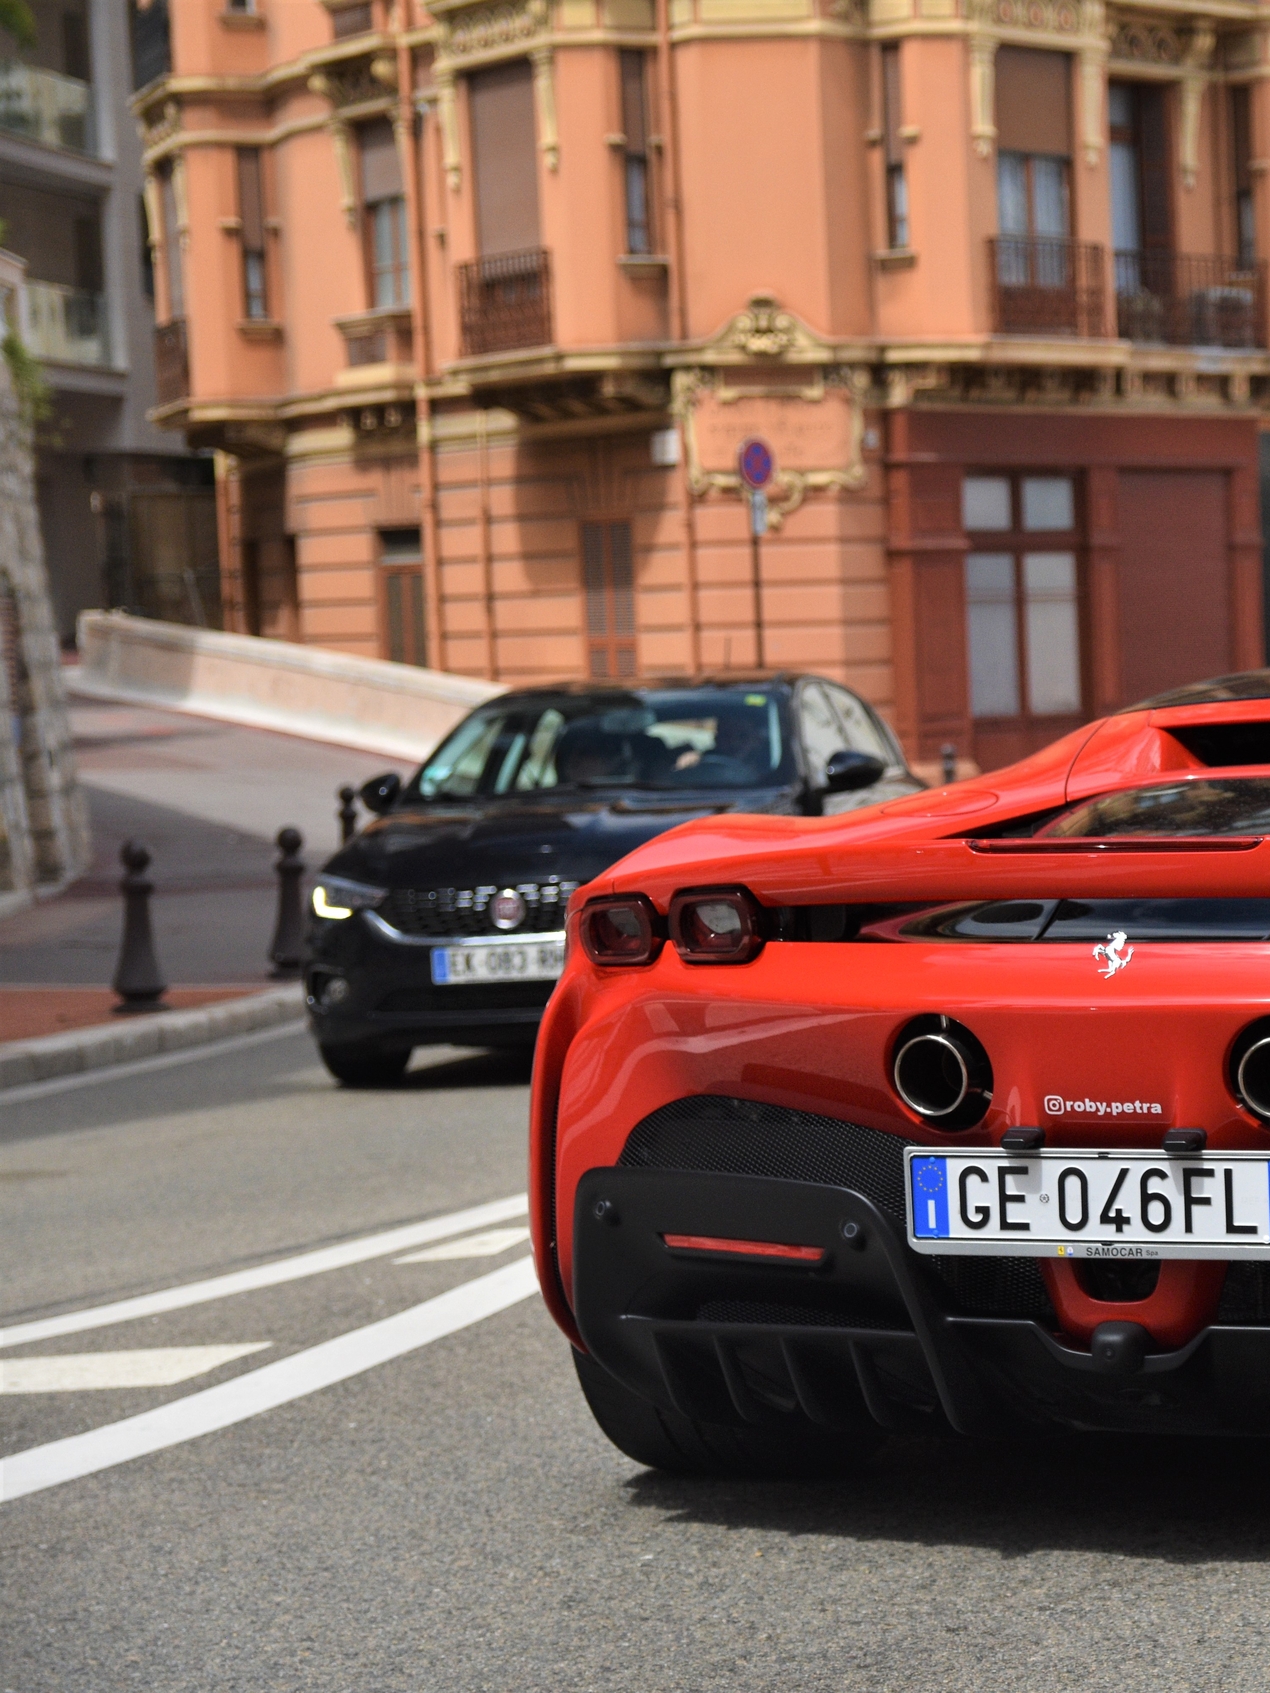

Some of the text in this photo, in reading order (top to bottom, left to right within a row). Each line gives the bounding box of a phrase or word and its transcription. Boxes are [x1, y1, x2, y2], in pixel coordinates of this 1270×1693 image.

[1065, 1098, 1163, 1116] roby.petra
[958, 1165, 1031, 1232] GE
[1057, 1166, 1259, 1235] 046FL
[1085, 1246, 1144, 1257] SAMOCAR
